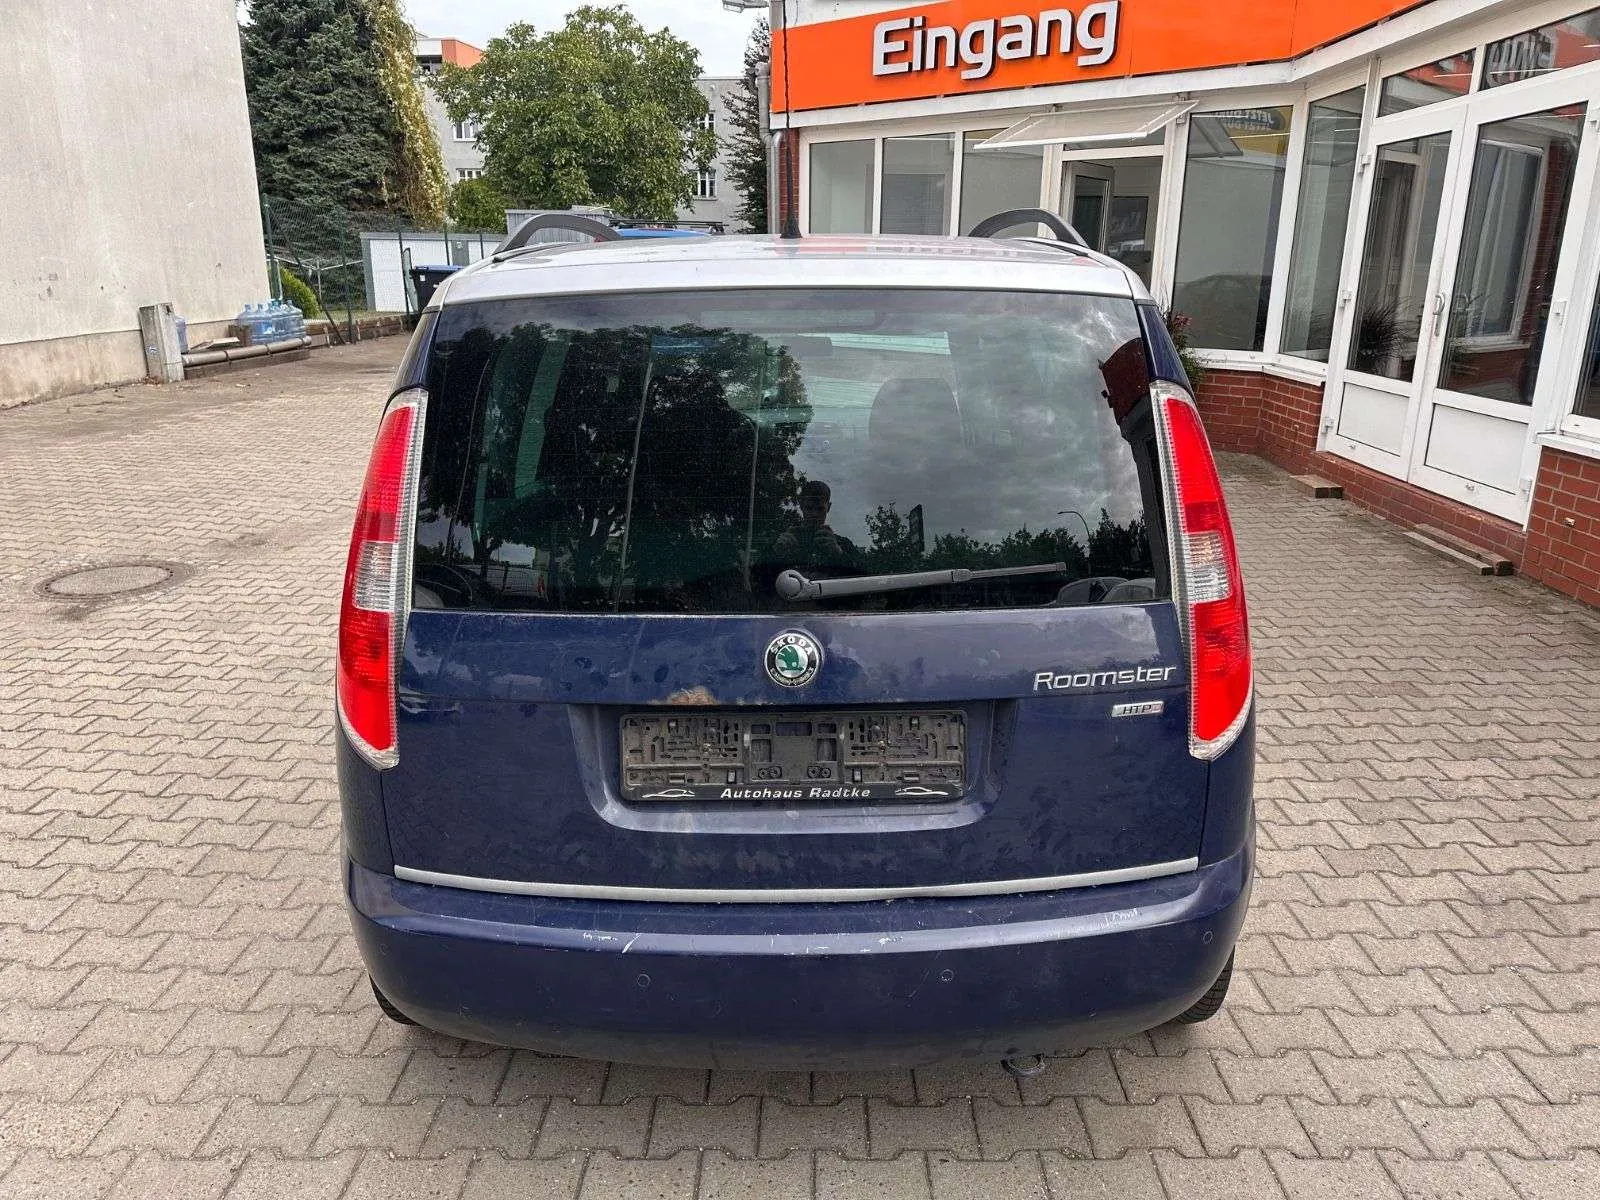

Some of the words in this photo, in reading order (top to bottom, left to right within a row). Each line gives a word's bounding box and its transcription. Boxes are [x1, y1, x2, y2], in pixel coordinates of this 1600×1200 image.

[872, 0, 1119, 80] Eingang
[1033, 666, 1177, 691] Roomster
[720, 788, 803, 799] Autohaus
[809, 787, 871, 798] Radtke
